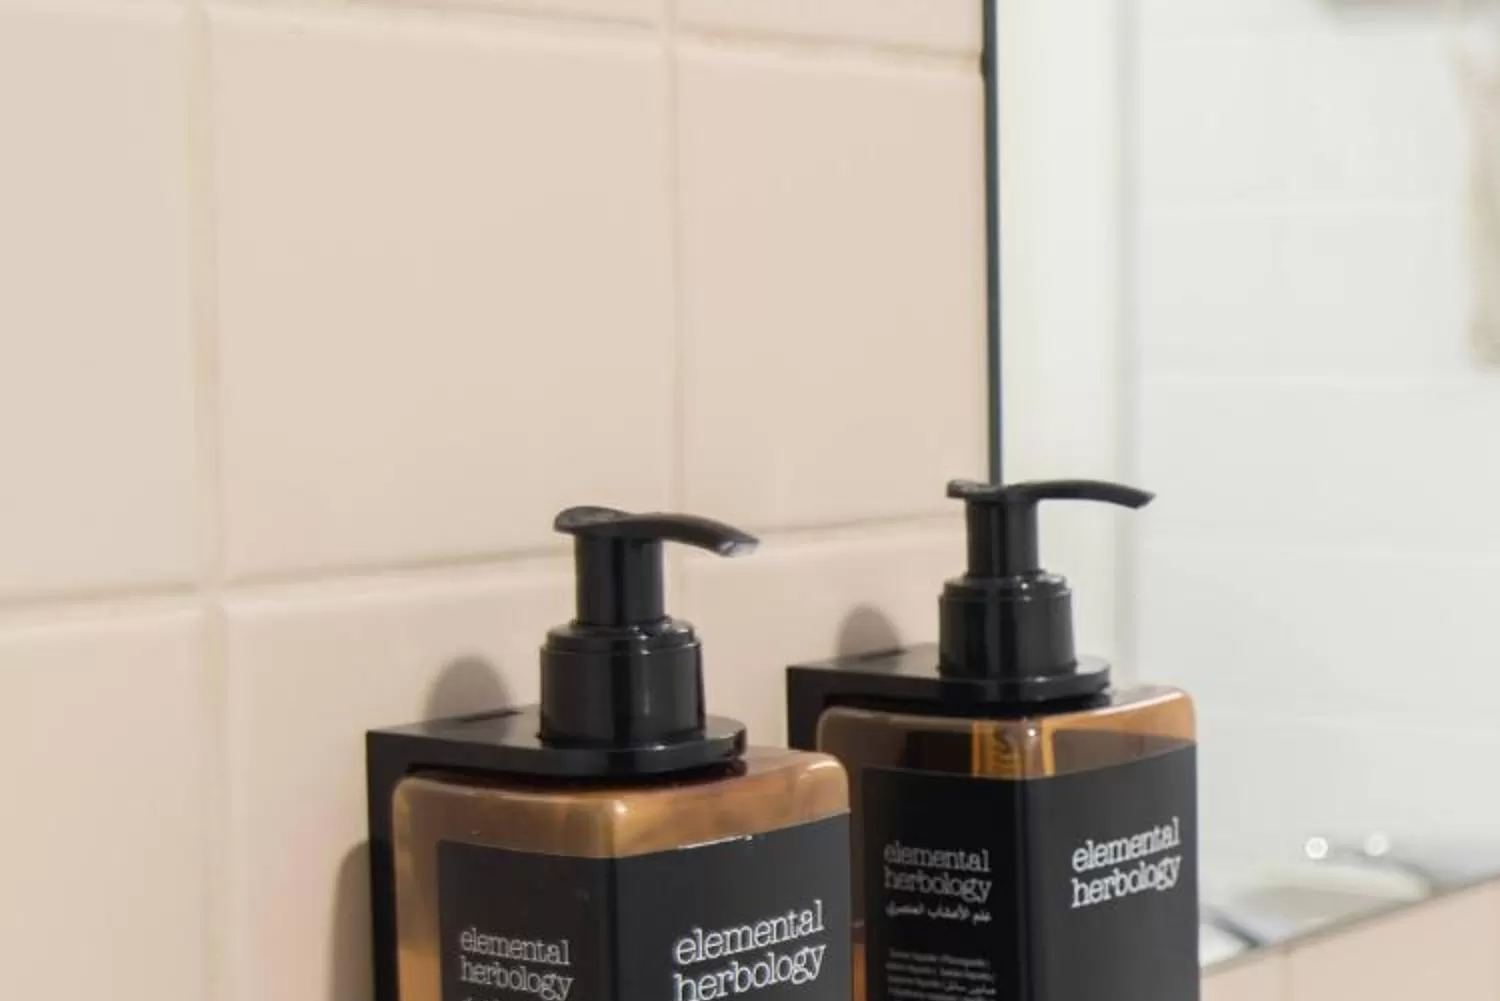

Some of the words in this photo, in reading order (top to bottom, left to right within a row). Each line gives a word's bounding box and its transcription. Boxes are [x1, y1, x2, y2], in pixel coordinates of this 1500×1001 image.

[884, 839, 991, 872] elemental
[1072, 816, 1181, 872] elemental
[884, 865, 993, 903] herbology
[1070, 855, 1182, 908] herbology
[460, 927, 571, 966] elemental
[675, 898, 825, 965] elemental
[459, 954, 575, 1001] herbology
